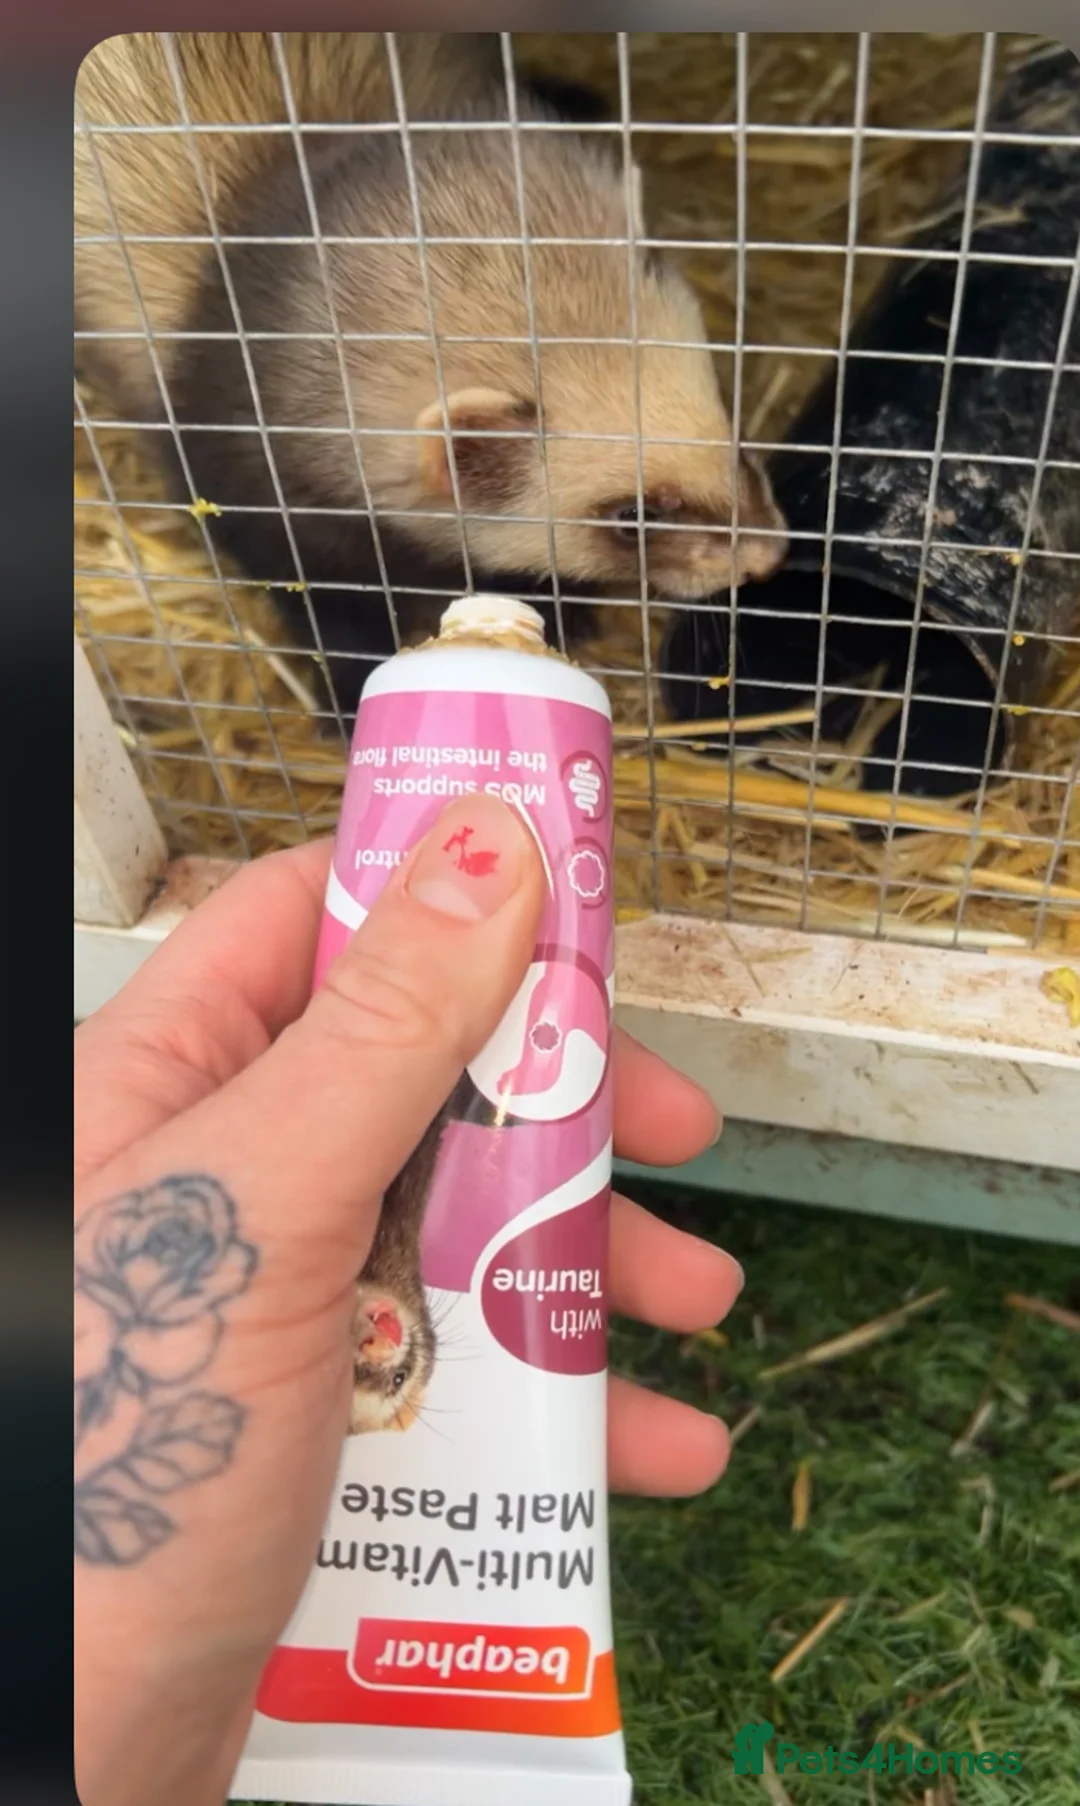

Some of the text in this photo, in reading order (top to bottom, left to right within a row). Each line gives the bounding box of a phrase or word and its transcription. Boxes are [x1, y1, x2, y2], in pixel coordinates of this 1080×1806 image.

[352, 746, 547, 772] the intestinal flora
[373, 775, 546, 805] MOS supports
[355, 848, 409, 870] ntrol
[492, 1268, 603, 1301] Taurine
[550, 1309, 602, 1340] with
[341, 1482, 595, 1533] Malt Paste
[316, 1538, 594, 1591] Multi-Vitam
[374, 1634, 570, 1684] beaphar
